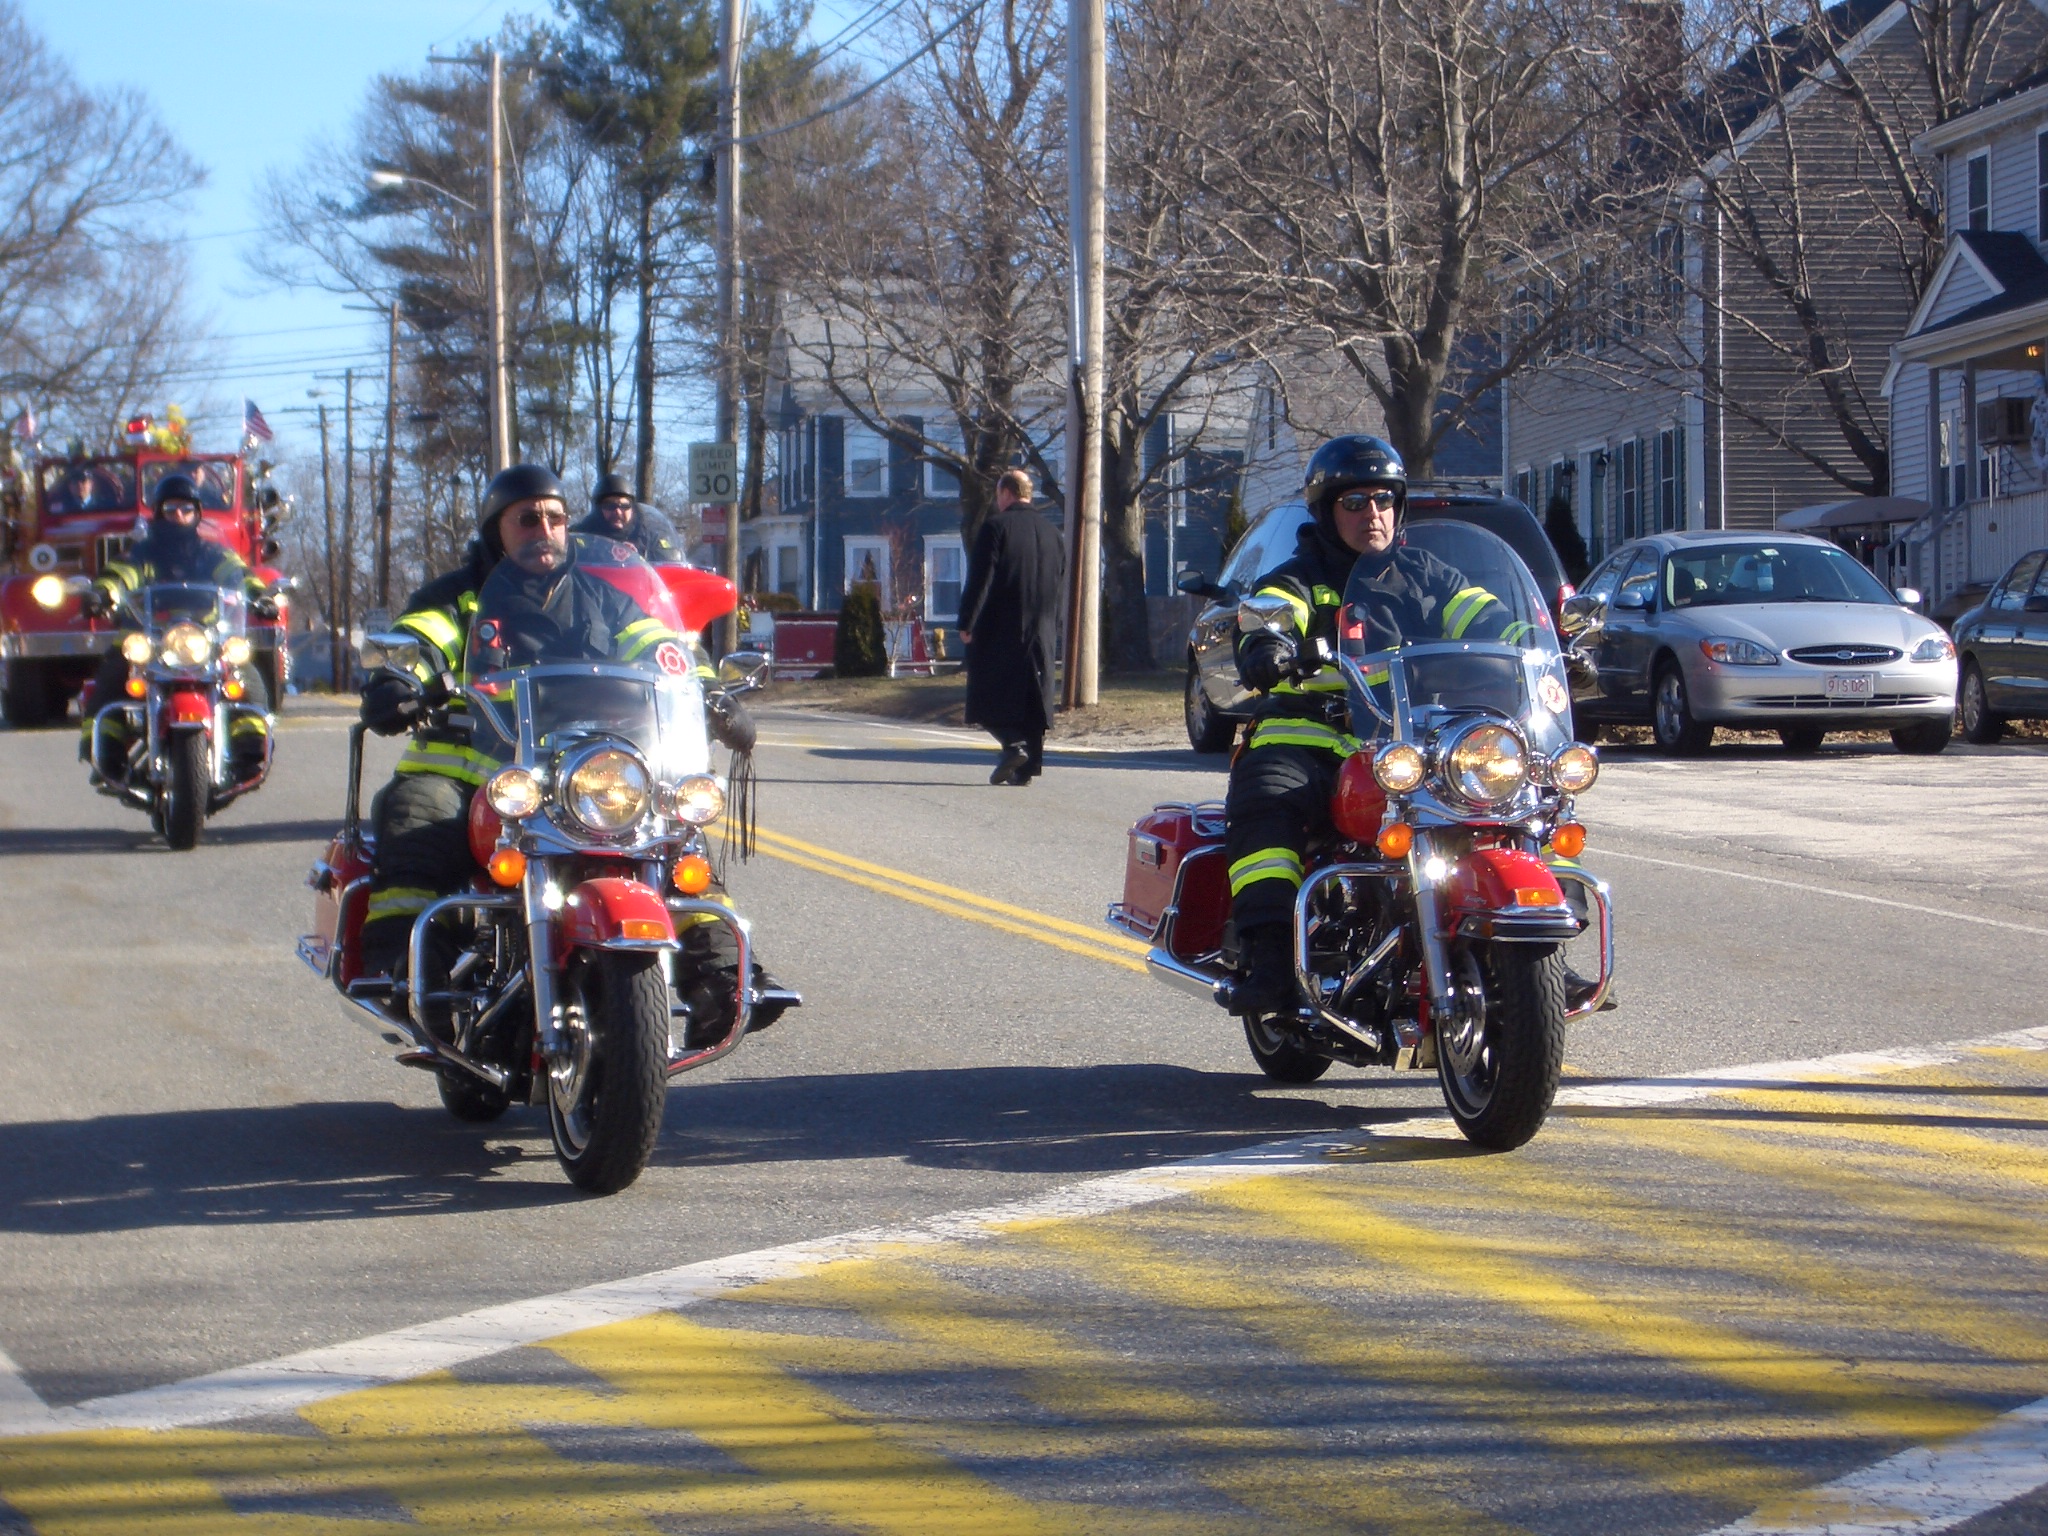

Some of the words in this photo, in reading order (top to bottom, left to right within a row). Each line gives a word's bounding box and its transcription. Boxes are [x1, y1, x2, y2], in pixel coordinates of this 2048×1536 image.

[696, 448, 733, 459] SPEED
[697, 461, 728, 471] LIMIT
[695, 473, 731, 496] 30
